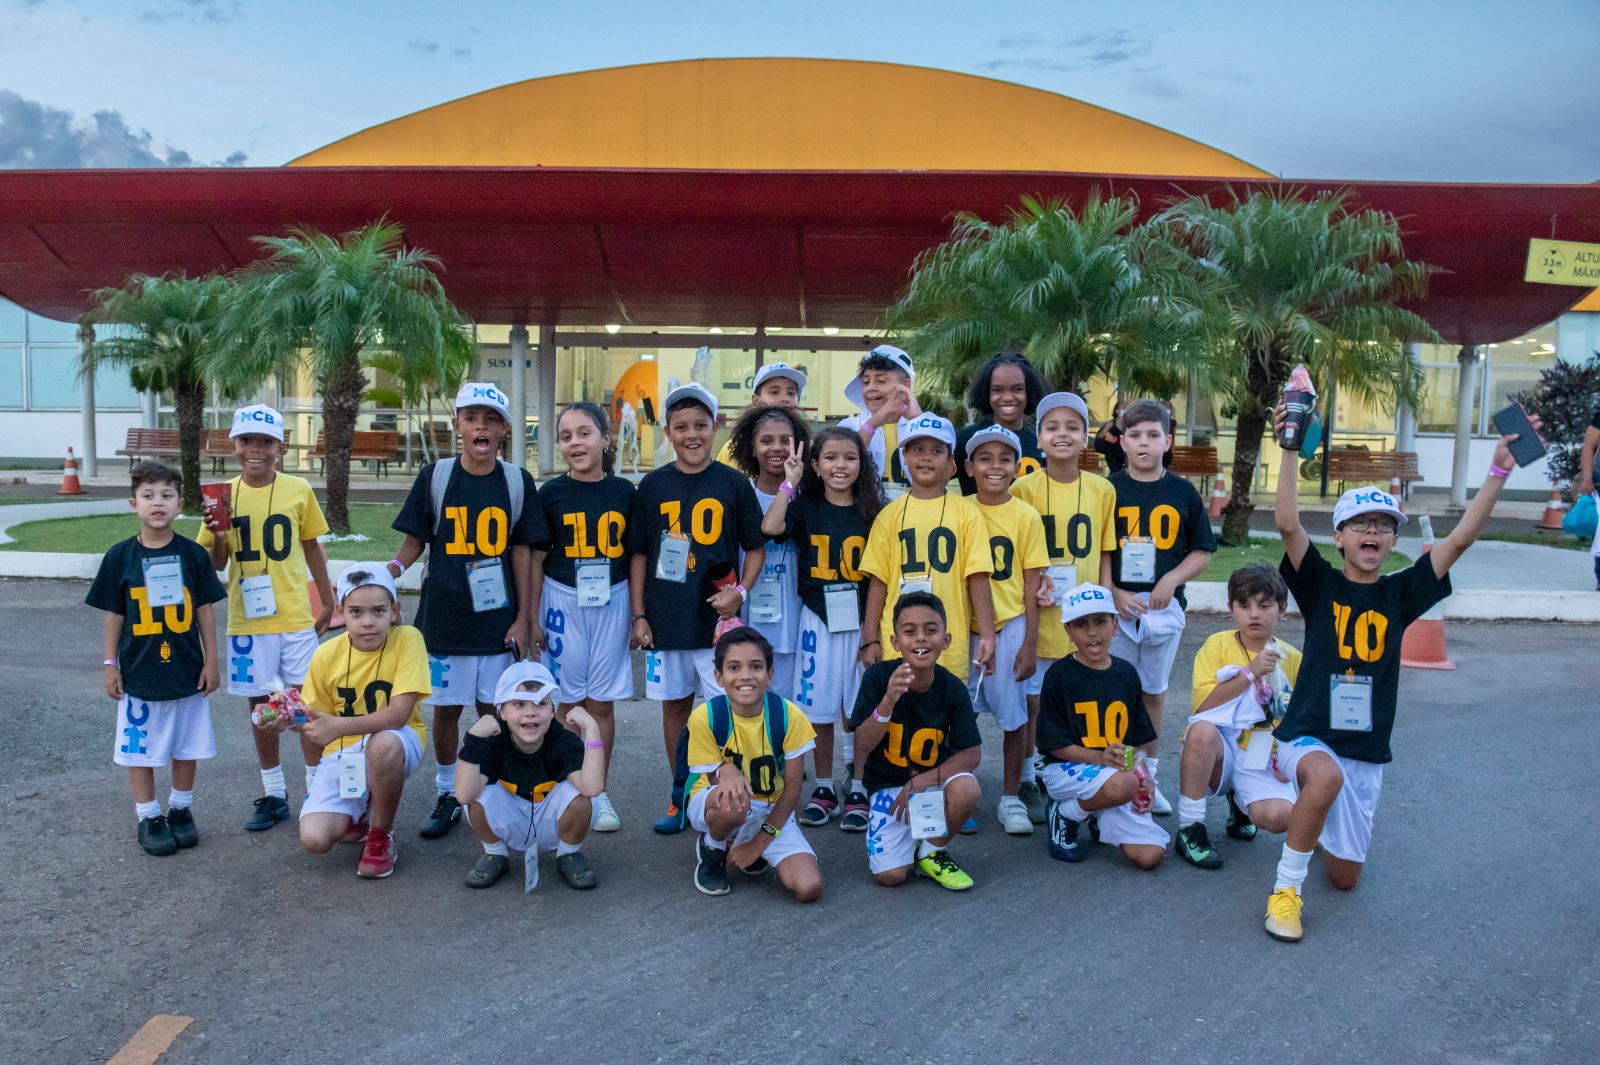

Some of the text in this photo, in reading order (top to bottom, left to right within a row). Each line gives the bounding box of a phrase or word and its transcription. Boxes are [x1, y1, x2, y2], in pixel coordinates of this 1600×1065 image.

[1574, 251, 1600, 264] ALTU
[487, 358, 506, 368] SUS
[232, 513, 292, 562] 10
[445, 506, 508, 556] 10
[563, 510, 626, 559] 10
[660, 498, 724, 546] 10
[1040, 513, 1092, 559] 10
[1119, 504, 1181, 550] 10
[810, 534, 867, 581] 10
[899, 526, 957, 574] 10
[130, 586, 193, 636] 10
[1333, 601, 1388, 663] 10
[336, 680, 394, 718] 10
[884, 722, 945, 767] 10
[1075, 700, 1129, 748] 10
